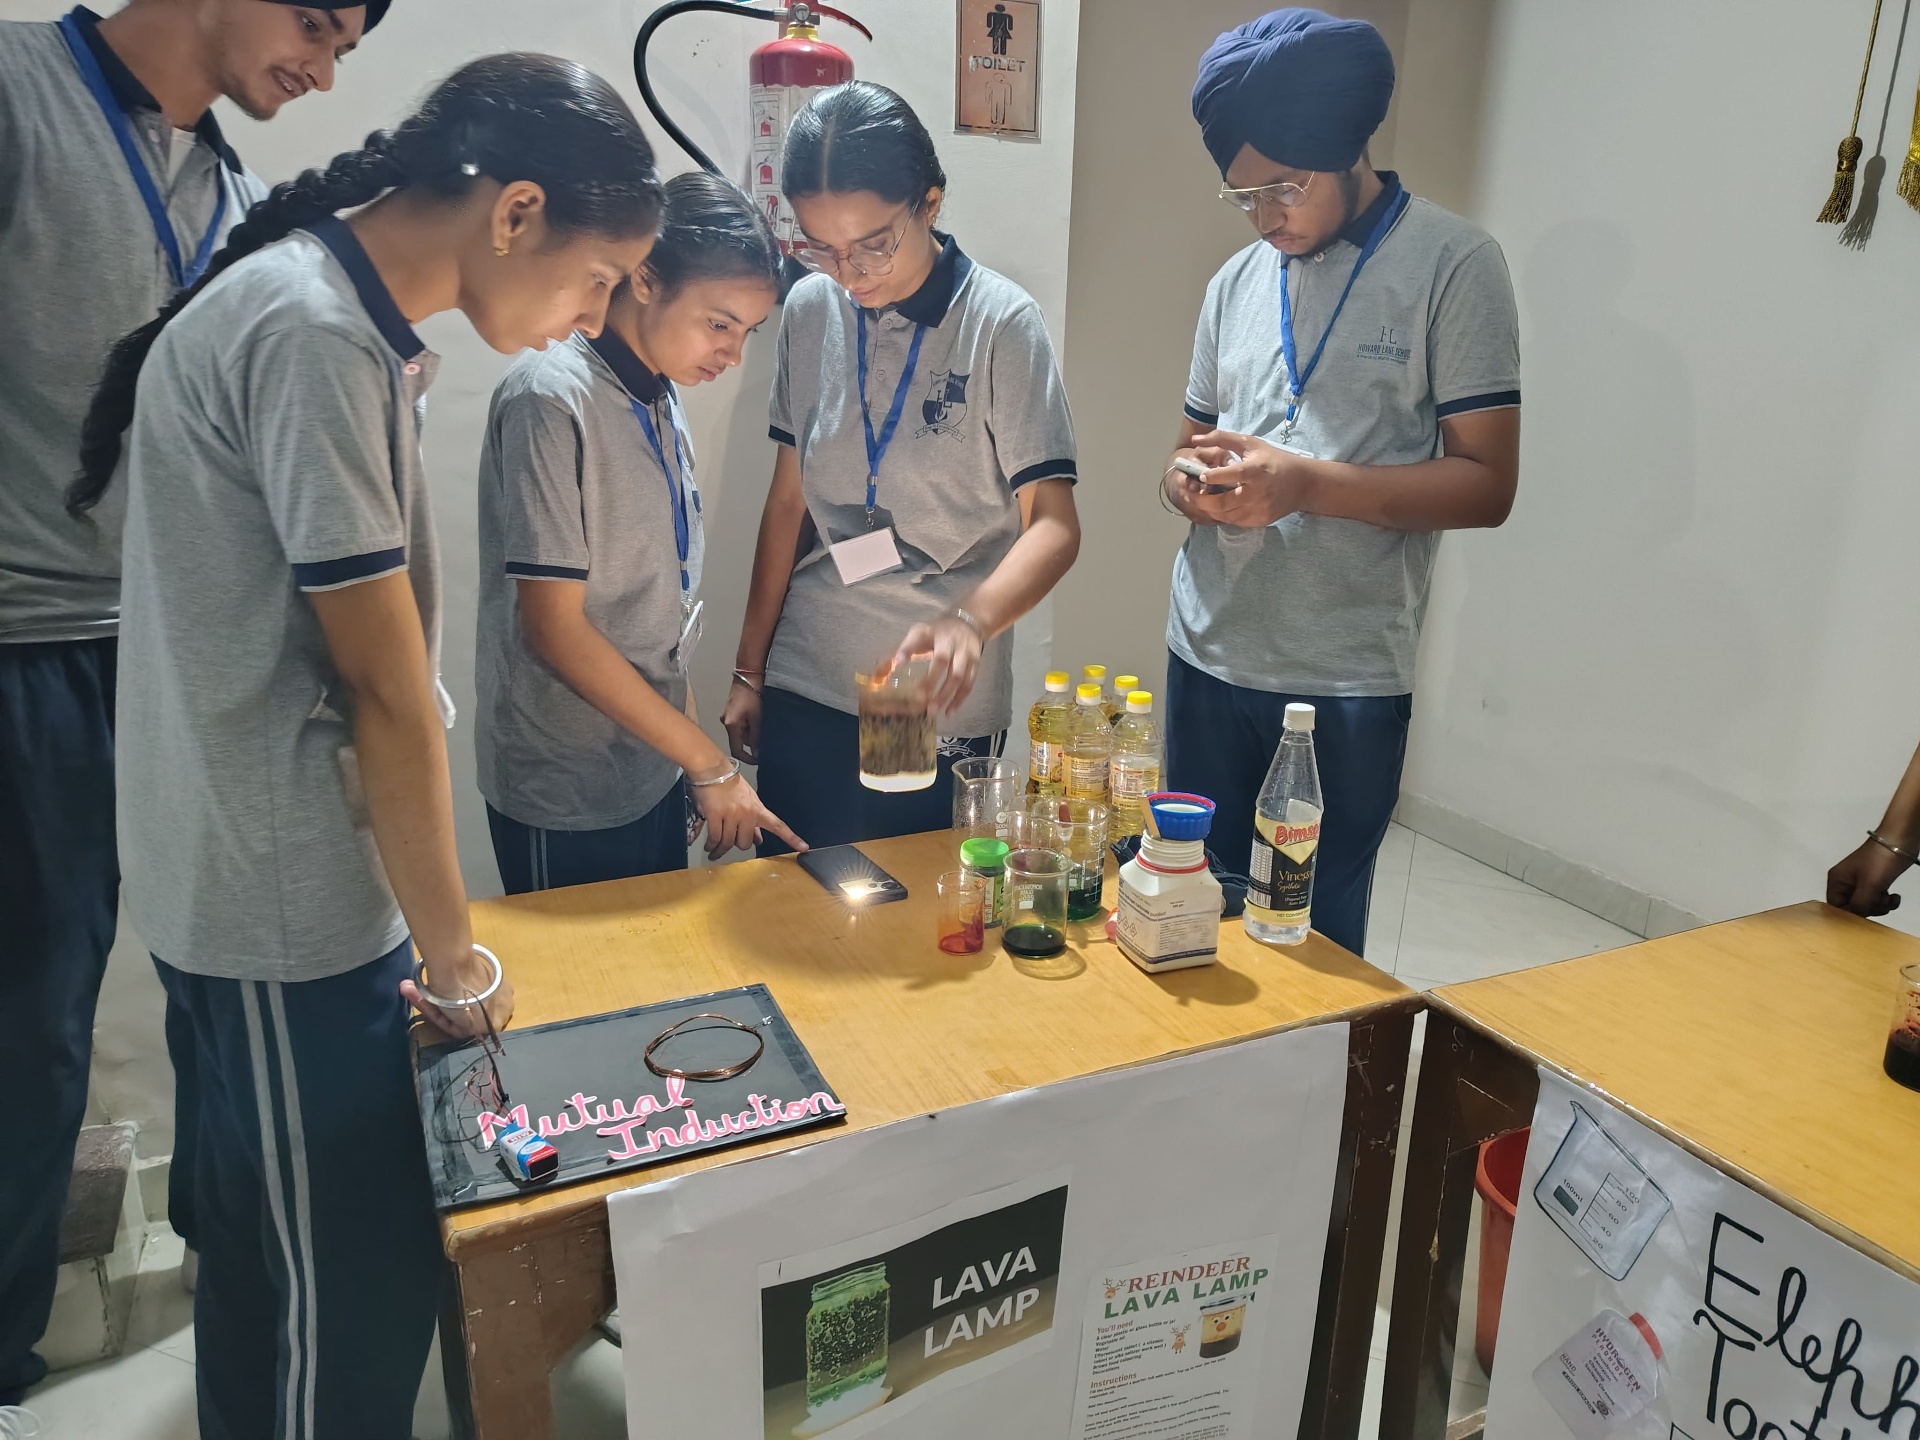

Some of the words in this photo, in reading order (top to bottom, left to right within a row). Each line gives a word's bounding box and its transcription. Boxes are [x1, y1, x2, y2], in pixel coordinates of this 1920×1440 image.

[970, 55, 1025, 72] TOILET
[477, 1069, 694, 1150] Mutual
[596, 1091, 845, 1160] Induction
[1625, 1187, 1640, 1204] 100
[1615, 1200, 1627, 1212] 80
[1608, 1213, 1619, 1225] 60
[1600, 1226, 1611, 1237] 40
[1592, 1238, 1603, 1249] 20
[933, 1246, 1037, 1310] LAVA
[1127, 1256, 1251, 1293] REINDEER
[1104, 1287, 1180, 1319] LAVA
[1193, 1268, 1268, 1300] LAMP
[924, 1288, 1040, 1359] LAMP
[1097, 1324, 1116, 1334] You'll
[1117, 1320, 1134, 1330] need
[1560, 1353, 1577, 1372] NANO
[1595, 1328, 1641, 1391] HYDROGEN
[1090, 1373, 1137, 1389] Instructions
